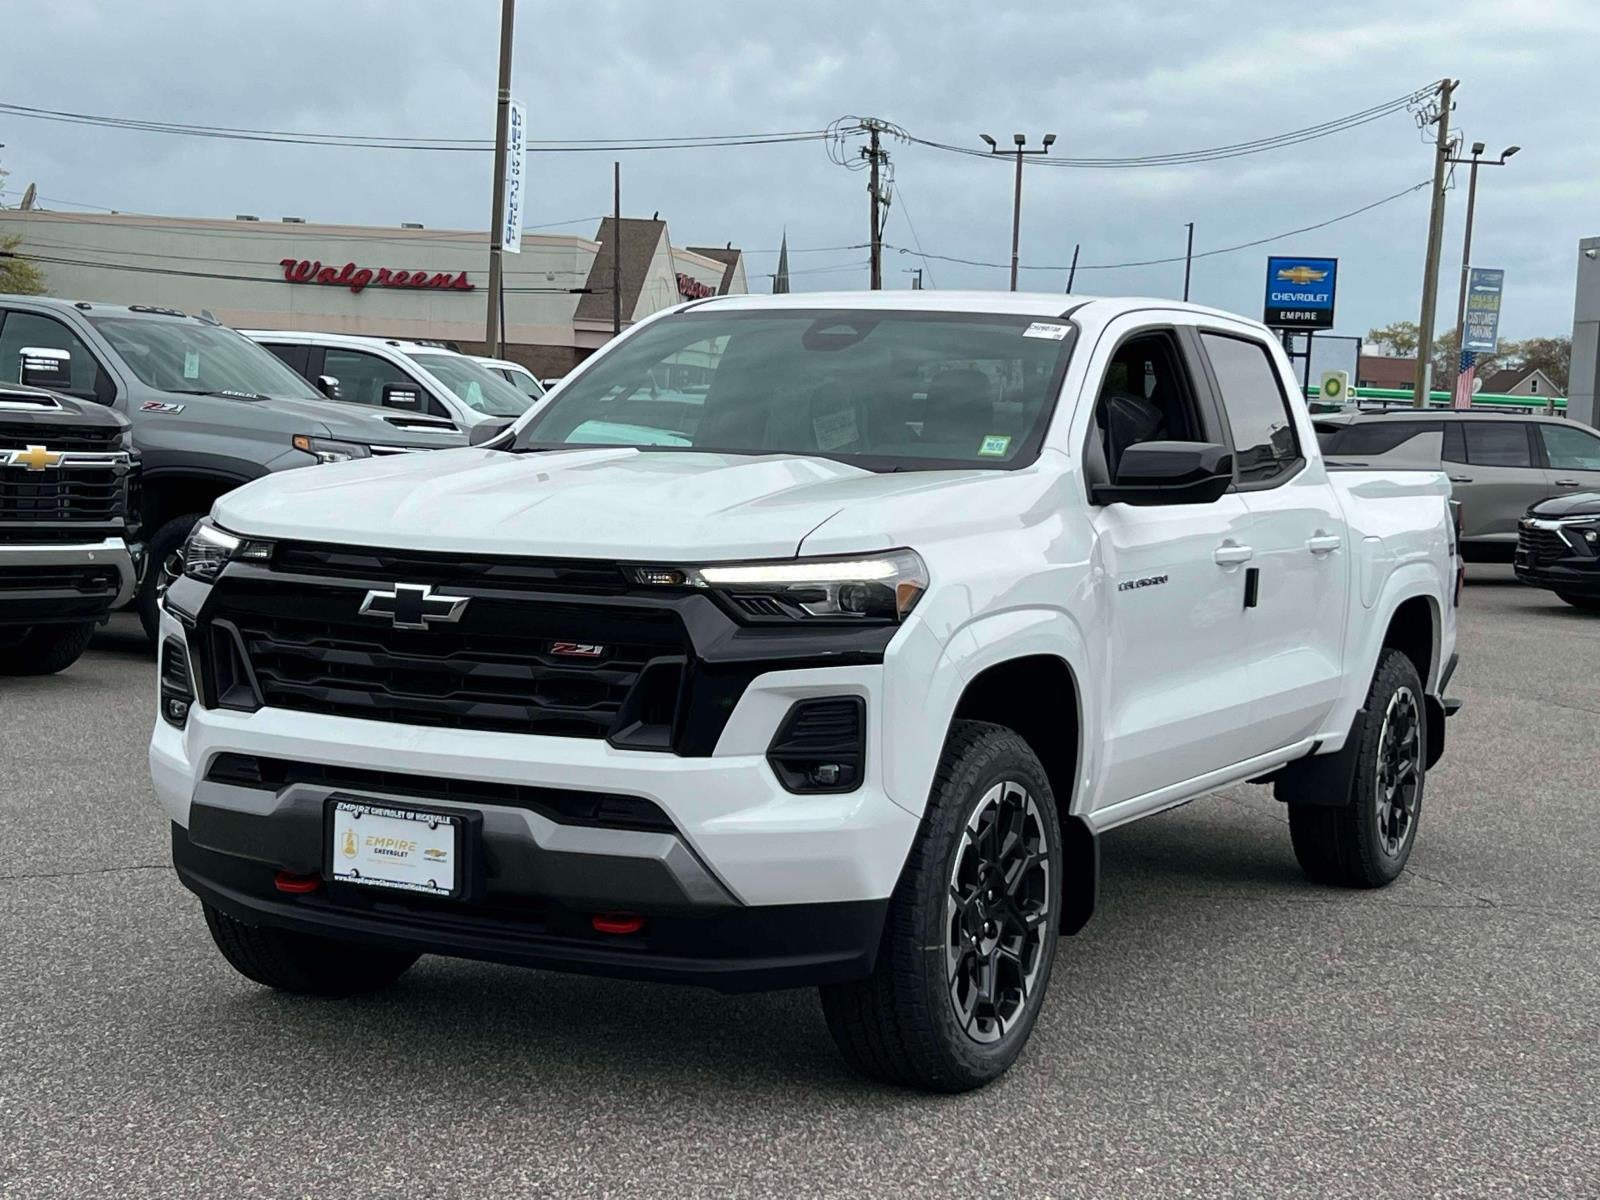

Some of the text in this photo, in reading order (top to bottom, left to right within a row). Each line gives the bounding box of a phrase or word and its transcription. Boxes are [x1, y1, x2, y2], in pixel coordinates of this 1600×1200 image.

[280, 259, 475, 294] Walgreens
[1271, 292, 1329, 302] CHEVROLET
[1280, 311, 1318, 320] EMPIRE
[140, 401, 185, 415] Z71
[551, 642, 604, 657] Z71
[336, 802, 370, 814] EMPIRE
[366, 836, 418, 851] EMPIRE
[374, 847, 408, 857] CHEVROLET
